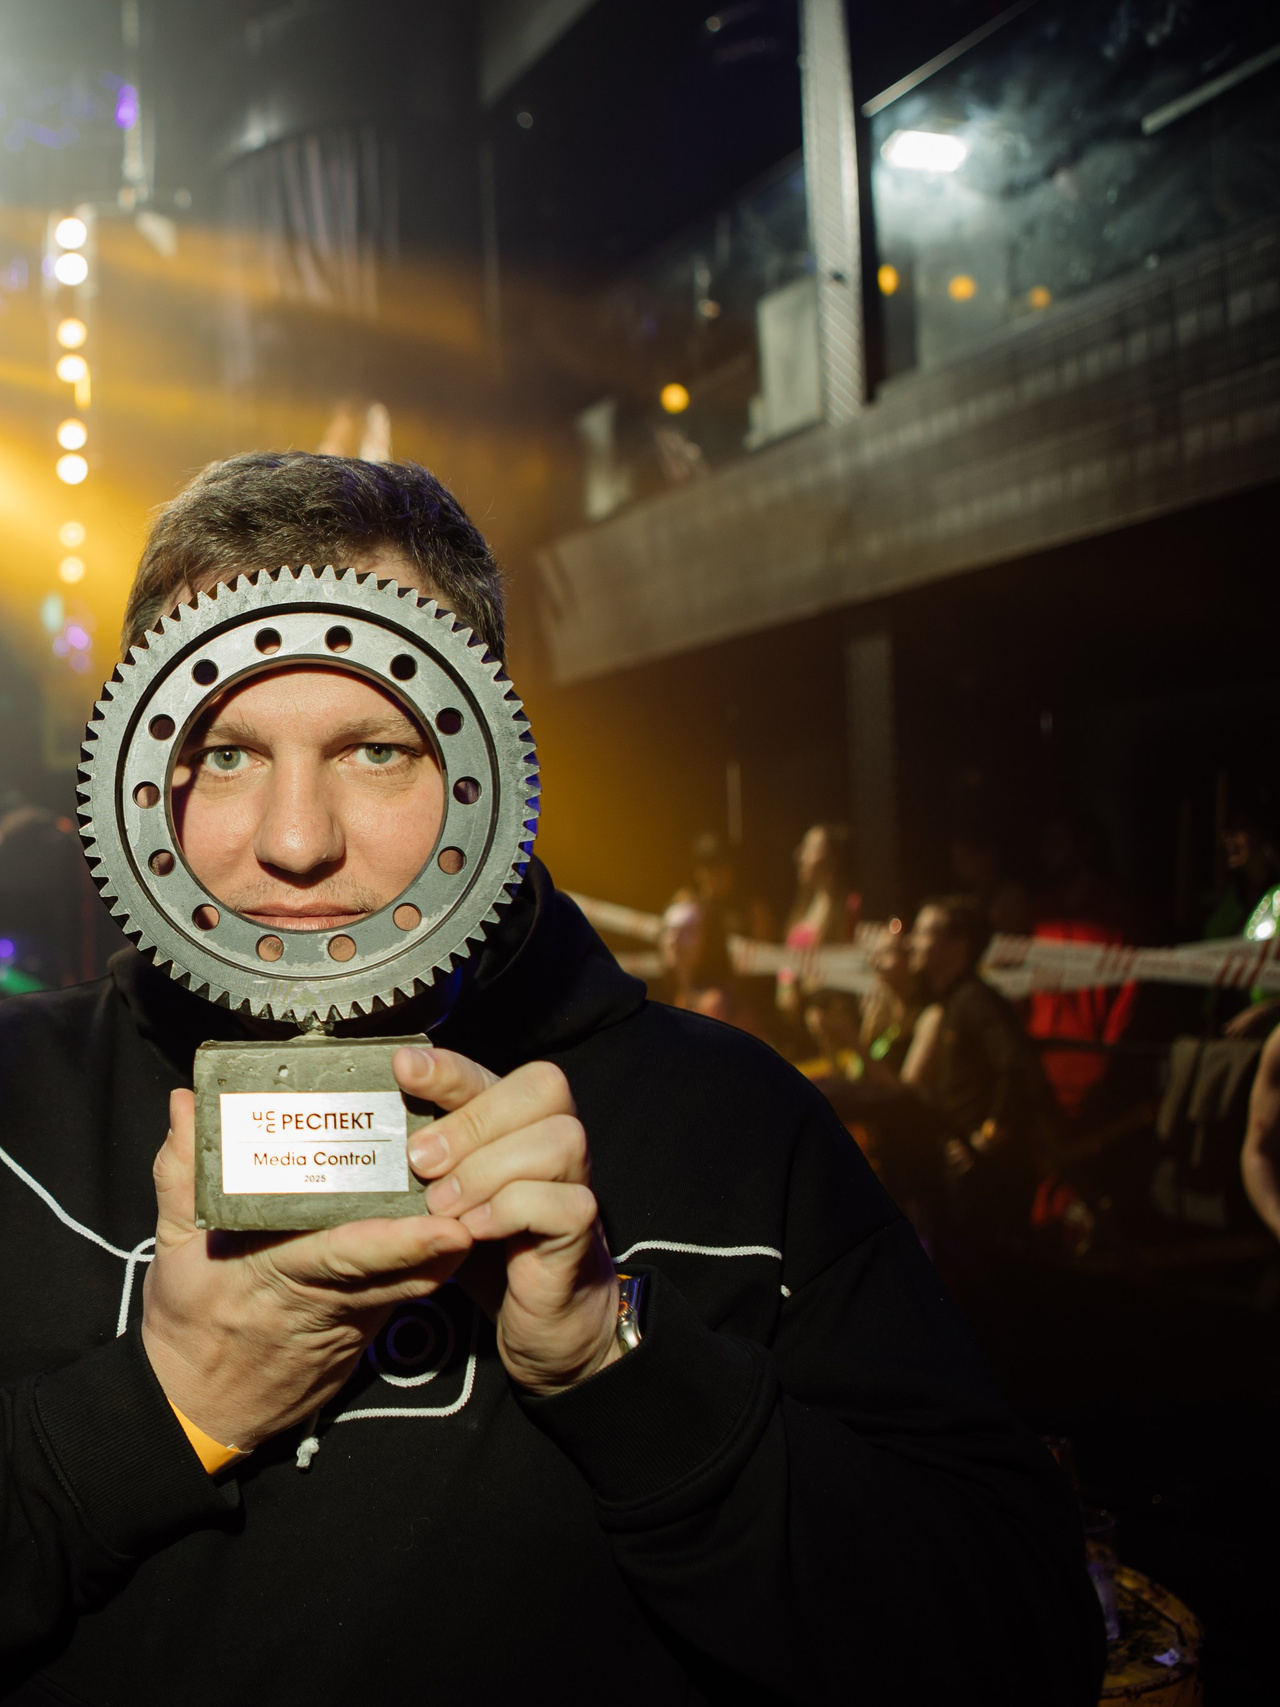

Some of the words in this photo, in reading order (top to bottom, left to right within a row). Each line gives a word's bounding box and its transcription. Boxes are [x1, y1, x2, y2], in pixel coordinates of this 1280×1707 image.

[281, 1112, 374, 1130] РЕСПЕКТ
[254, 1151, 307, 1166] Media
[313, 1149, 376, 1166] Control
[304, 1174, 327, 1183] 2025
